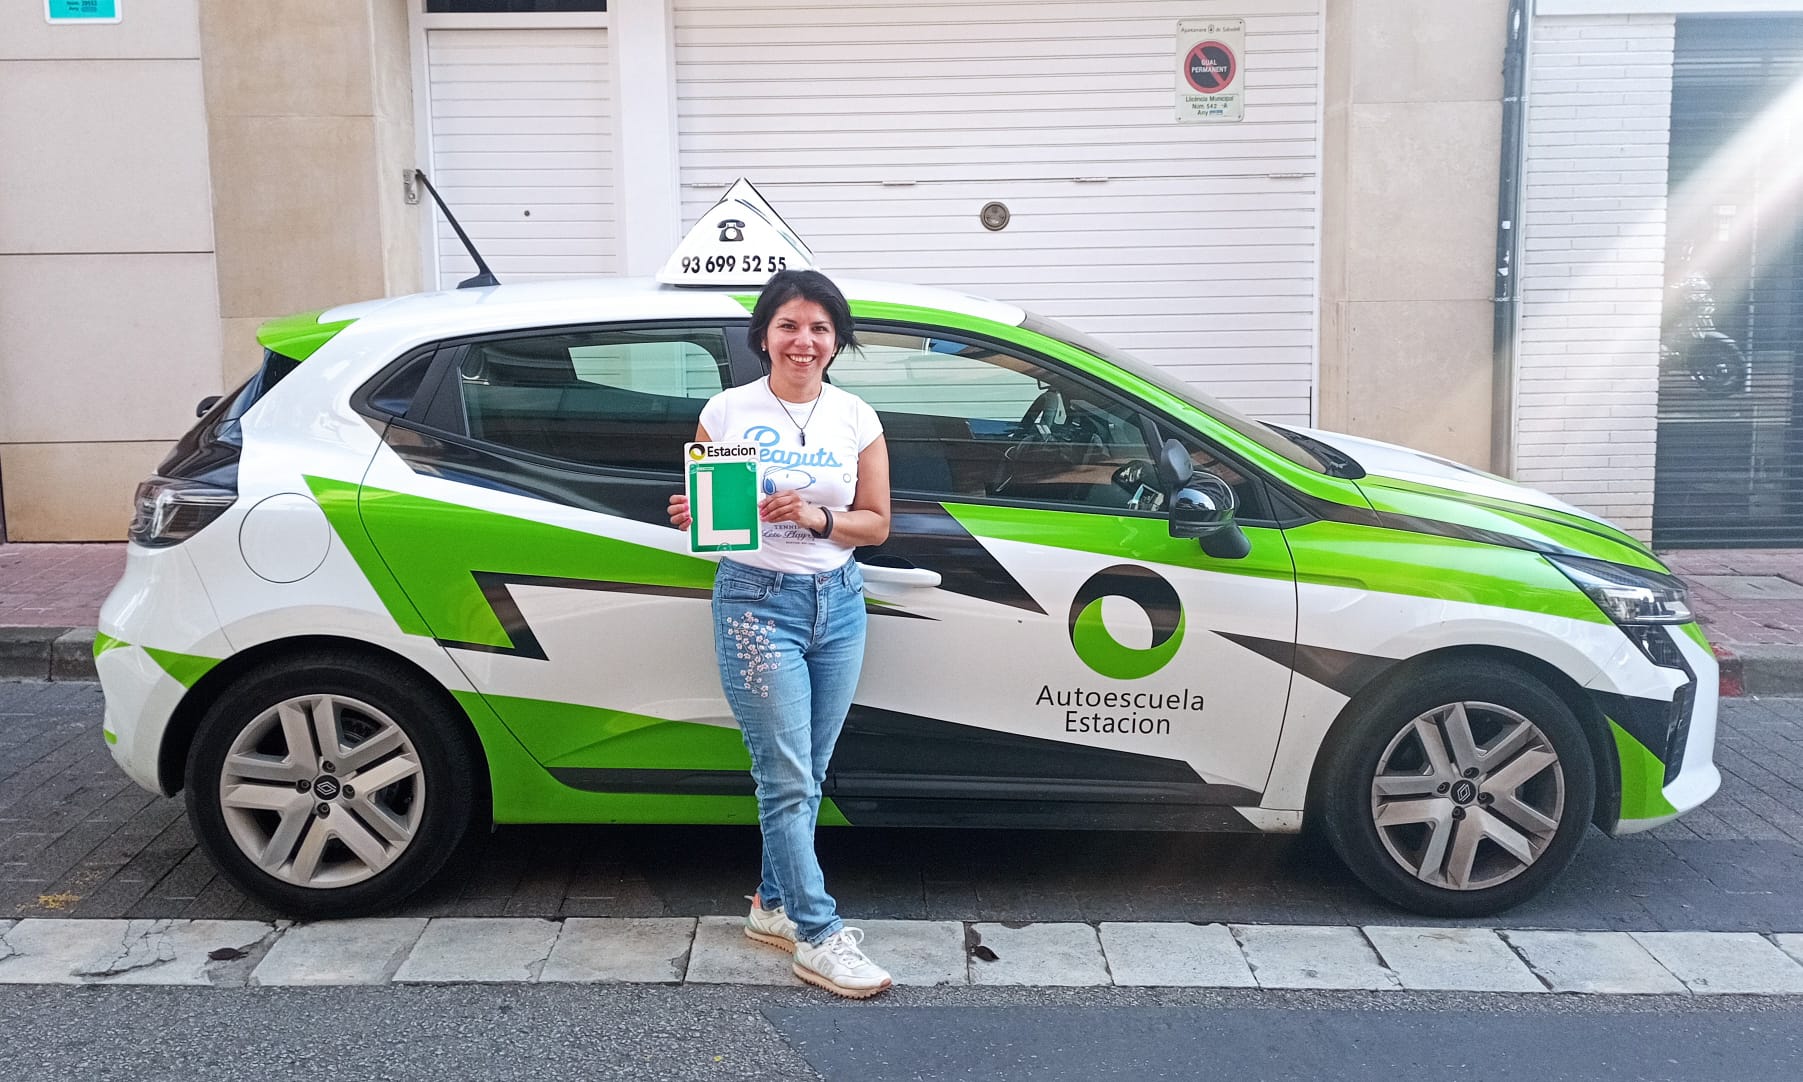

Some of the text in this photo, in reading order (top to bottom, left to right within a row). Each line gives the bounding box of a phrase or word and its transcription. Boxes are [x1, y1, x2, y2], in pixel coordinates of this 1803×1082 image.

[681, 255, 786, 273] 93 699 52 55
[707, 444, 756, 457] Estacion
[743, 425, 843, 470] Peanuts
[696, 471, 751, 546] L
[1036, 685, 1204, 711] Autoescuela
[1065, 711, 1170, 734] Estacion
